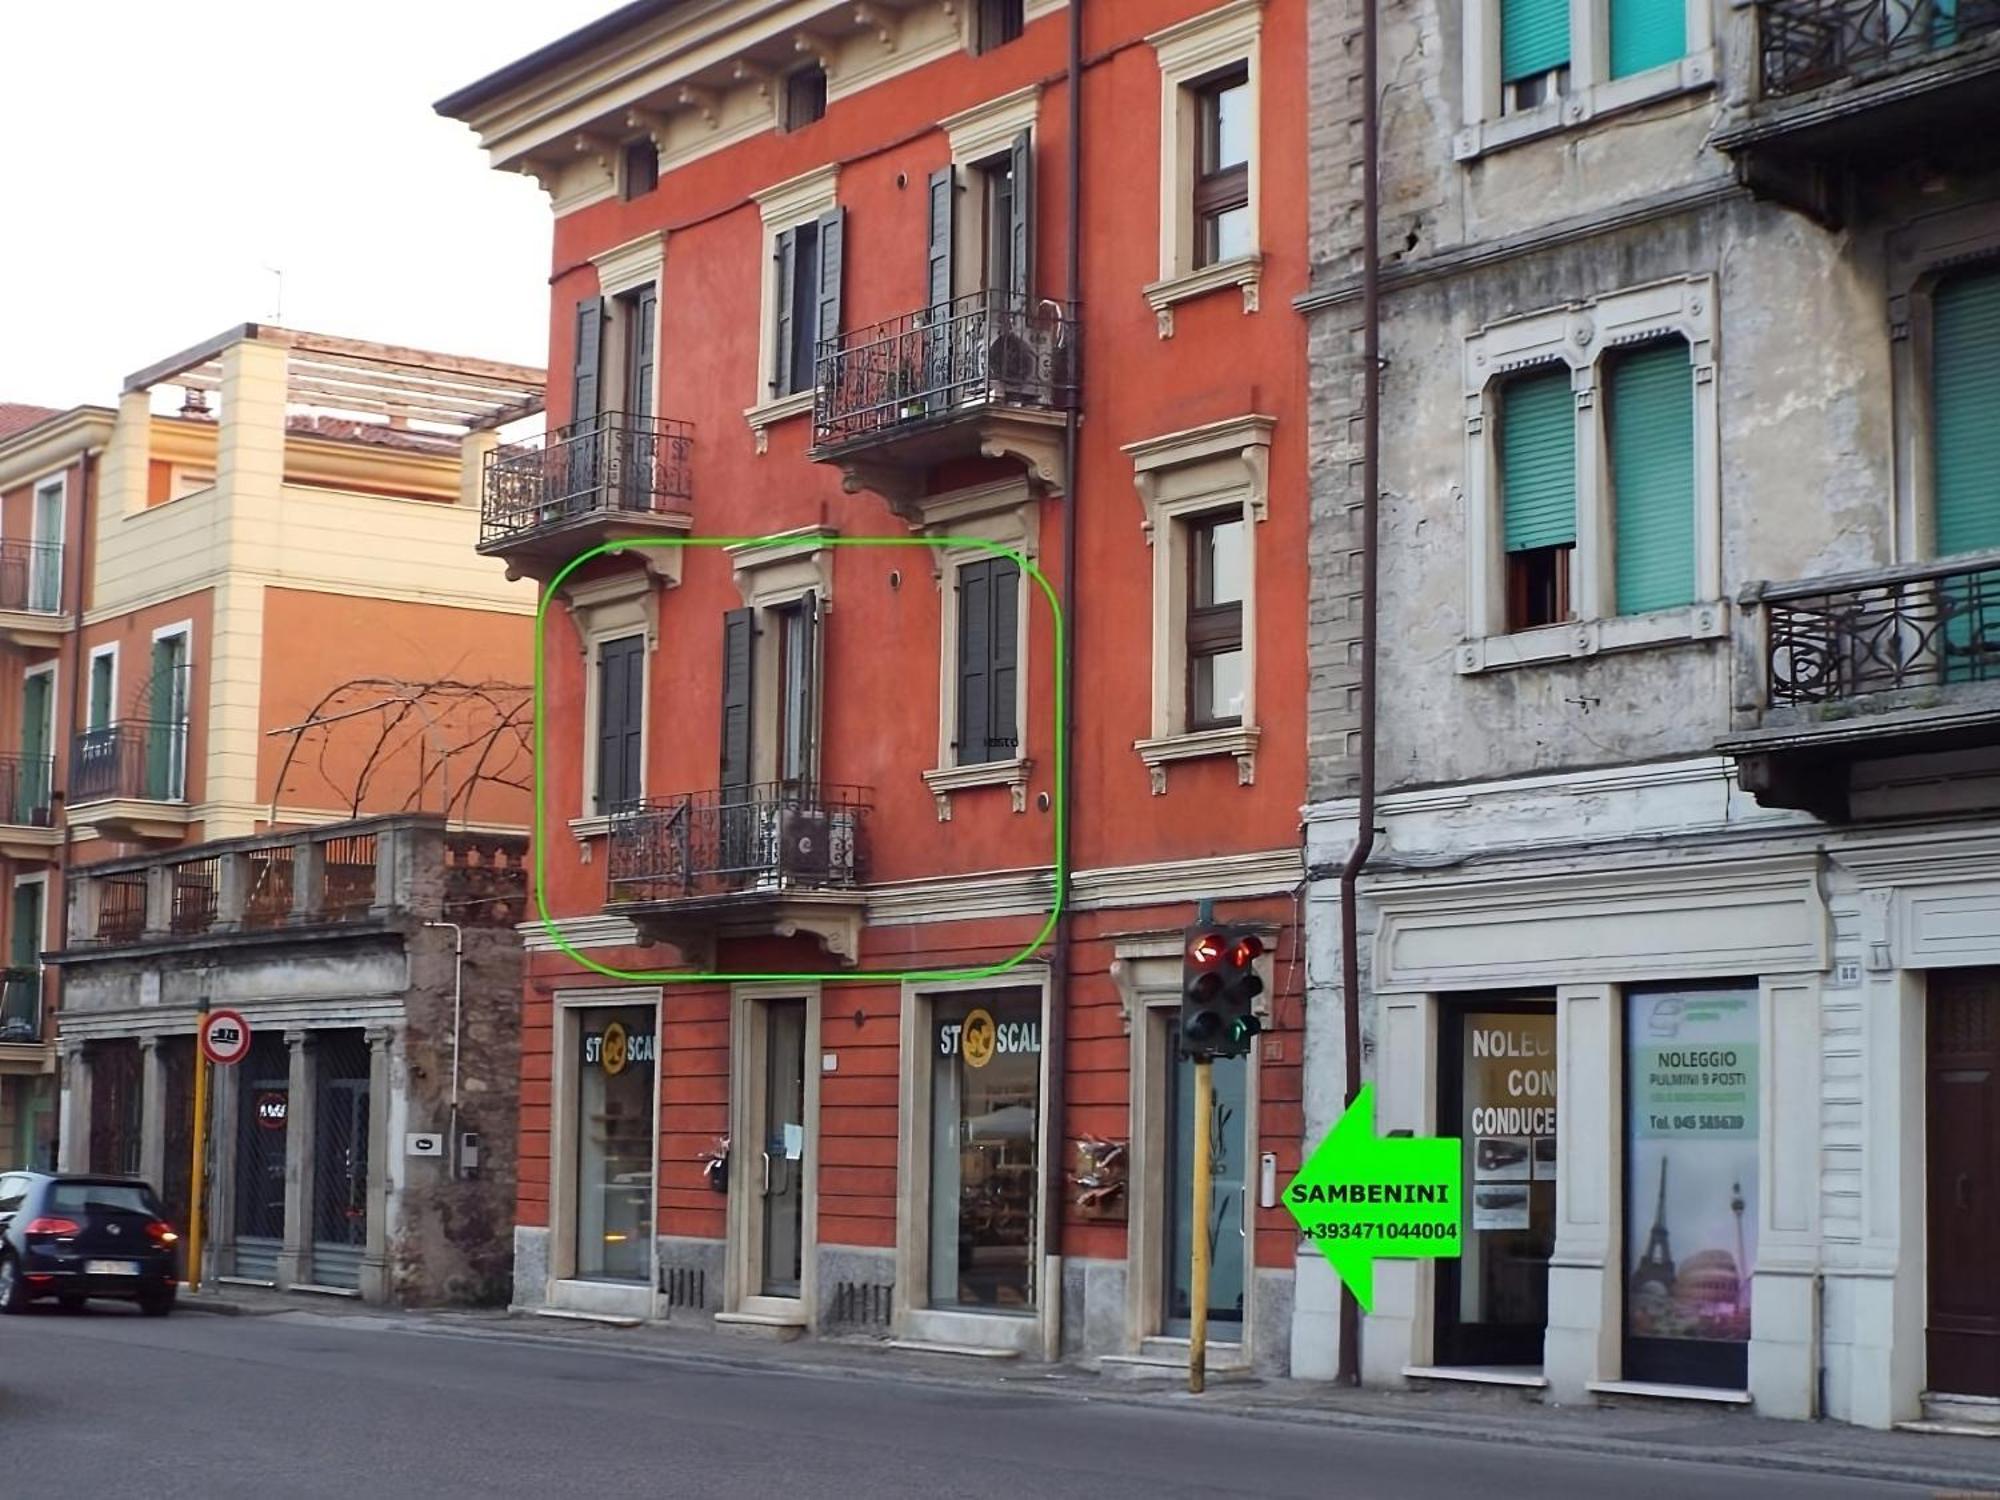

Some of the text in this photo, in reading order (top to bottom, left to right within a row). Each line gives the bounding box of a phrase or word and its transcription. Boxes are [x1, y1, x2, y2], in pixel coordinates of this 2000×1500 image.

[1658, 1051, 1737, 1068] NOLEGGIO
[1508, 1069, 1557, 1097] CON
[1649, 1073, 1699, 1086] PULMINI
[1711, 1072, 1747, 1086] POSTI
[1471, 1107, 1556, 1135] CONDUCE
